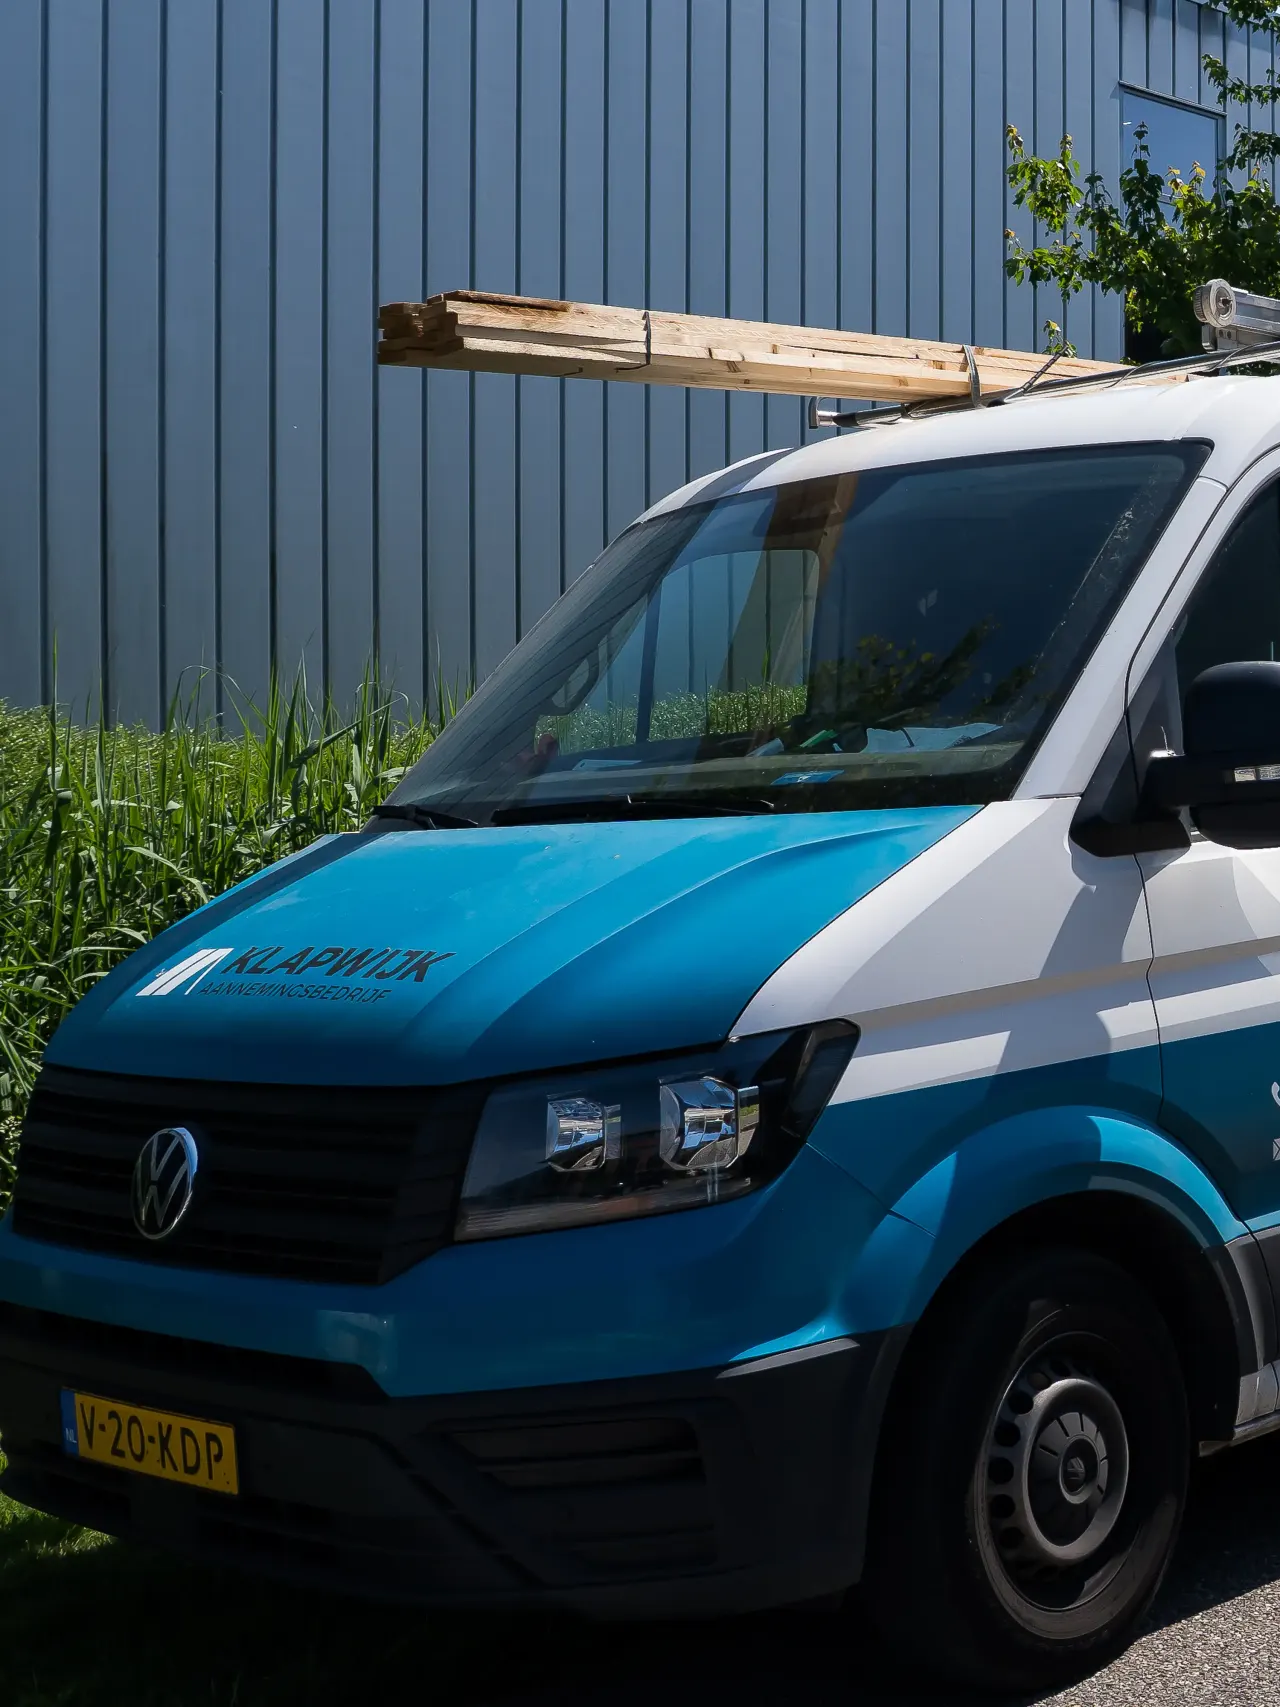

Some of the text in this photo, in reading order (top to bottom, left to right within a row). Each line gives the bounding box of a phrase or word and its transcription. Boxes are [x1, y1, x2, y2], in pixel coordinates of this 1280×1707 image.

[219, 945, 457, 983] KLAPWIJK
[197, 981, 392, 1004] AANNEMINGSBEDRIJF
[65, 1402, 224, 1481] NL V-20-KDP
